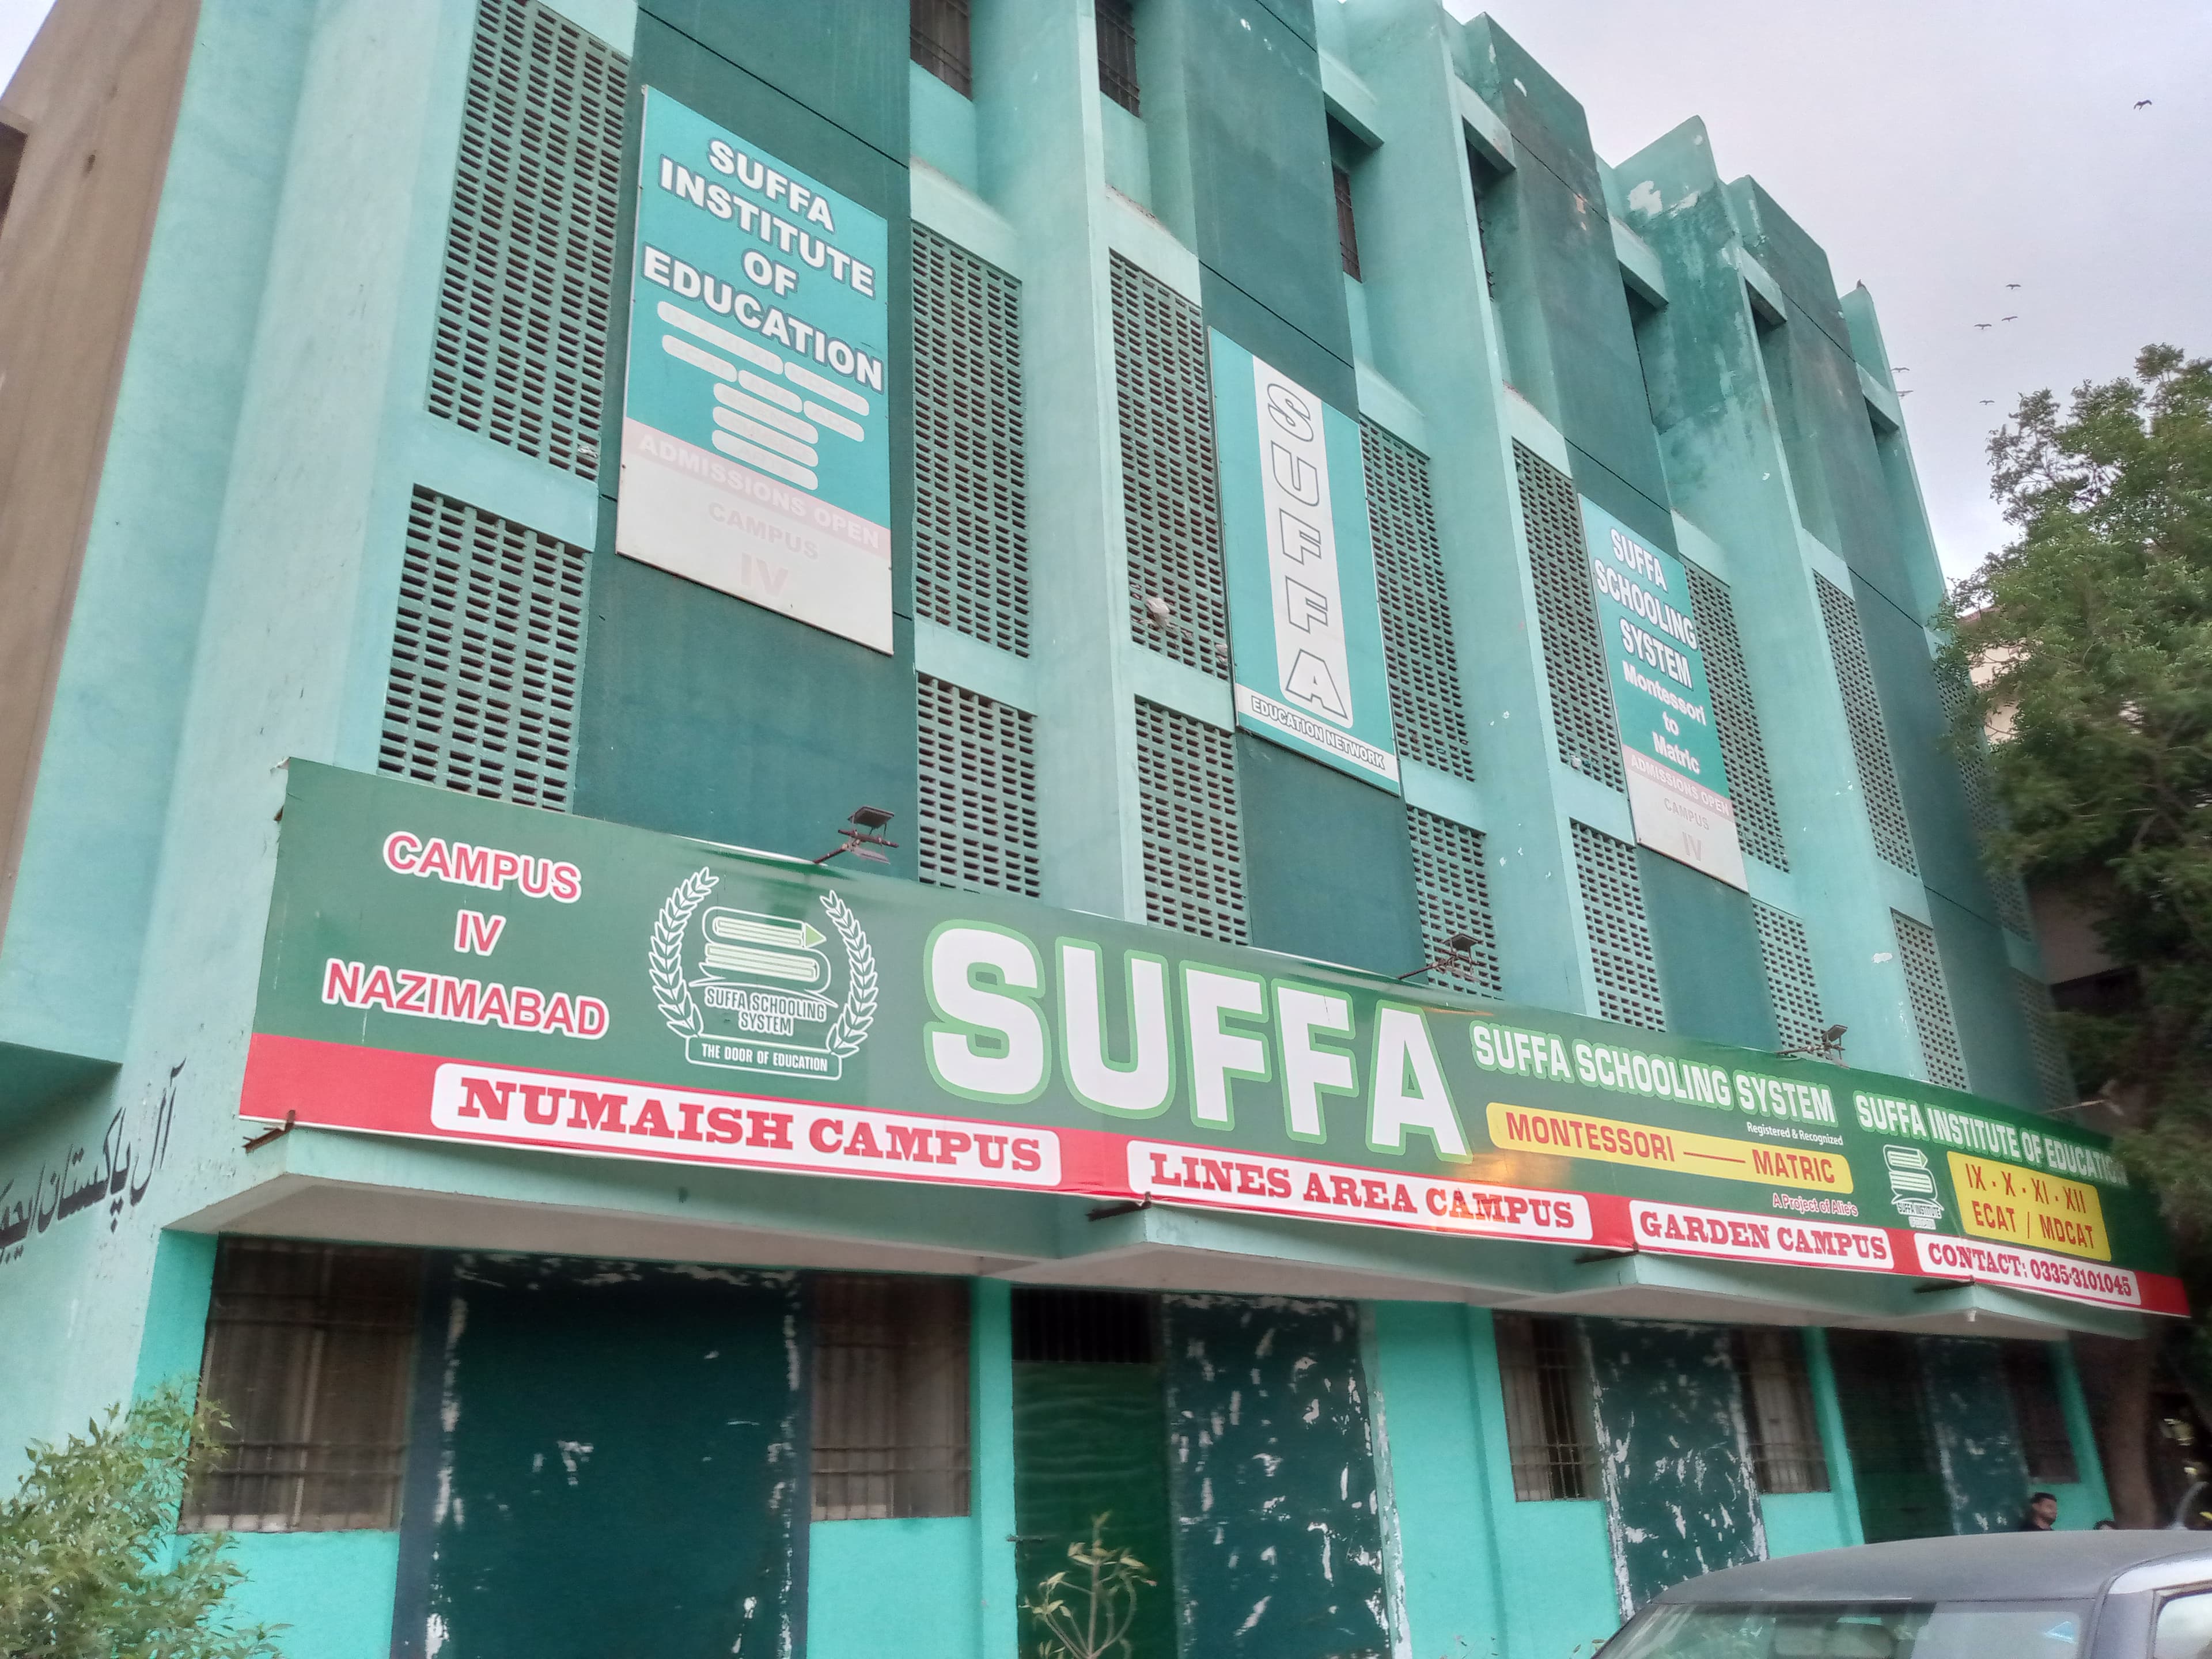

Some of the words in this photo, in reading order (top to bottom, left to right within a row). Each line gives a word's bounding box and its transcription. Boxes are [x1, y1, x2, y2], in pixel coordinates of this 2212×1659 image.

[708, 139, 835, 233] SUFFA
[658, 155, 876, 298] INSTITUTE
[741, 249, 798, 297] OF
[642, 244, 884, 393] EDUCATION
[640, 435, 805, 517] ADMISSIONS
[814, 508, 879, 548] OPEN
[709, 502, 819, 560] CAMPUS
[1267, 383, 1348, 719] SUFFA
[1610, 528, 1669, 593] SUFFA
[741, 552, 789, 597] IV
[1594, 558, 1698, 652] SCHOOLING
[1619, 616, 1693, 691] SYSTEM
[1622, 660, 1706, 726] Montessori
[1662, 711, 1679, 736] to
[1251, 695, 1324, 743] EDUCATION
[1325, 730, 1385, 770] NETWORK
[1652, 731, 1700, 774] Matric
[1631, 755, 1699, 800] ADMISSIONS
[1701, 791, 1729, 816] OPEN
[1664, 797, 1709, 830] CAMPUS
[384, 832, 581, 903] CAMPUS
[1682, 832, 1701, 862] IV
[454, 910, 505, 955] IV
[323, 959, 608, 1038] NAZIMABAD
[704, 986, 748, 1009] SUFFA
[751, 993, 827, 1021] SCHOOLING
[739, 1012, 794, 1036] SYSTEM
[702, 1043, 720, 1059] THE
[724, 1046, 753, 1062] DOOR
[756, 1050, 770, 1065] OF
[773, 1052, 827, 1071] EDUCATION
[924, 920, 1473, 1163] SUFFA
[1471, 1021, 1574, 1082] SUFFA
[1573, 1040, 1732, 1109] SCHOOLING
[1734, 1070, 1838, 1127] SYSTEM
[457, 1077, 793, 1150] NUMAISH
[809, 1118, 1041, 1172] CAMPUS
[1505, 1112, 1675, 1162] MONTESSORI
[1752, 1149, 1835, 1184] MATRIC
[1747, 1121, 1790, 1138] Registered
[1791, 1128, 1798, 1139] &
[1799, 1130, 1843, 1146] Recognized
[1854, 1091, 1928, 1139] SUFFA
[1926, 1104, 2022, 1161] INSTITUTE
[2020, 1128, 2042, 1165] OF
[1150, 1151, 1292, 1199] LINES
[1303, 1172, 1418, 1213] AREA
[1425, 1188, 1574, 1229] CAMPUS
[1773, 1192, 1781, 1208] A
[1781, 1193, 1819, 1214] Project
[1819, 1199, 1831, 1212] of
[1965, 1163, 1987, 1191] IX
[2001, 1171, 2016, 1196] X
[2031, 1177, 2050, 1205] XI
[2063, 1186, 2086, 1213] XII
[1639, 1211, 1770, 1249] GARDEN
[1777, 1226, 1888, 1260] CAMPUS
[1971, 1200, 2016, 1232] ECAT
[2039, 1213, 2094, 1249] MDCAT
[1928, 1243, 2027, 1278] CONTACT:
